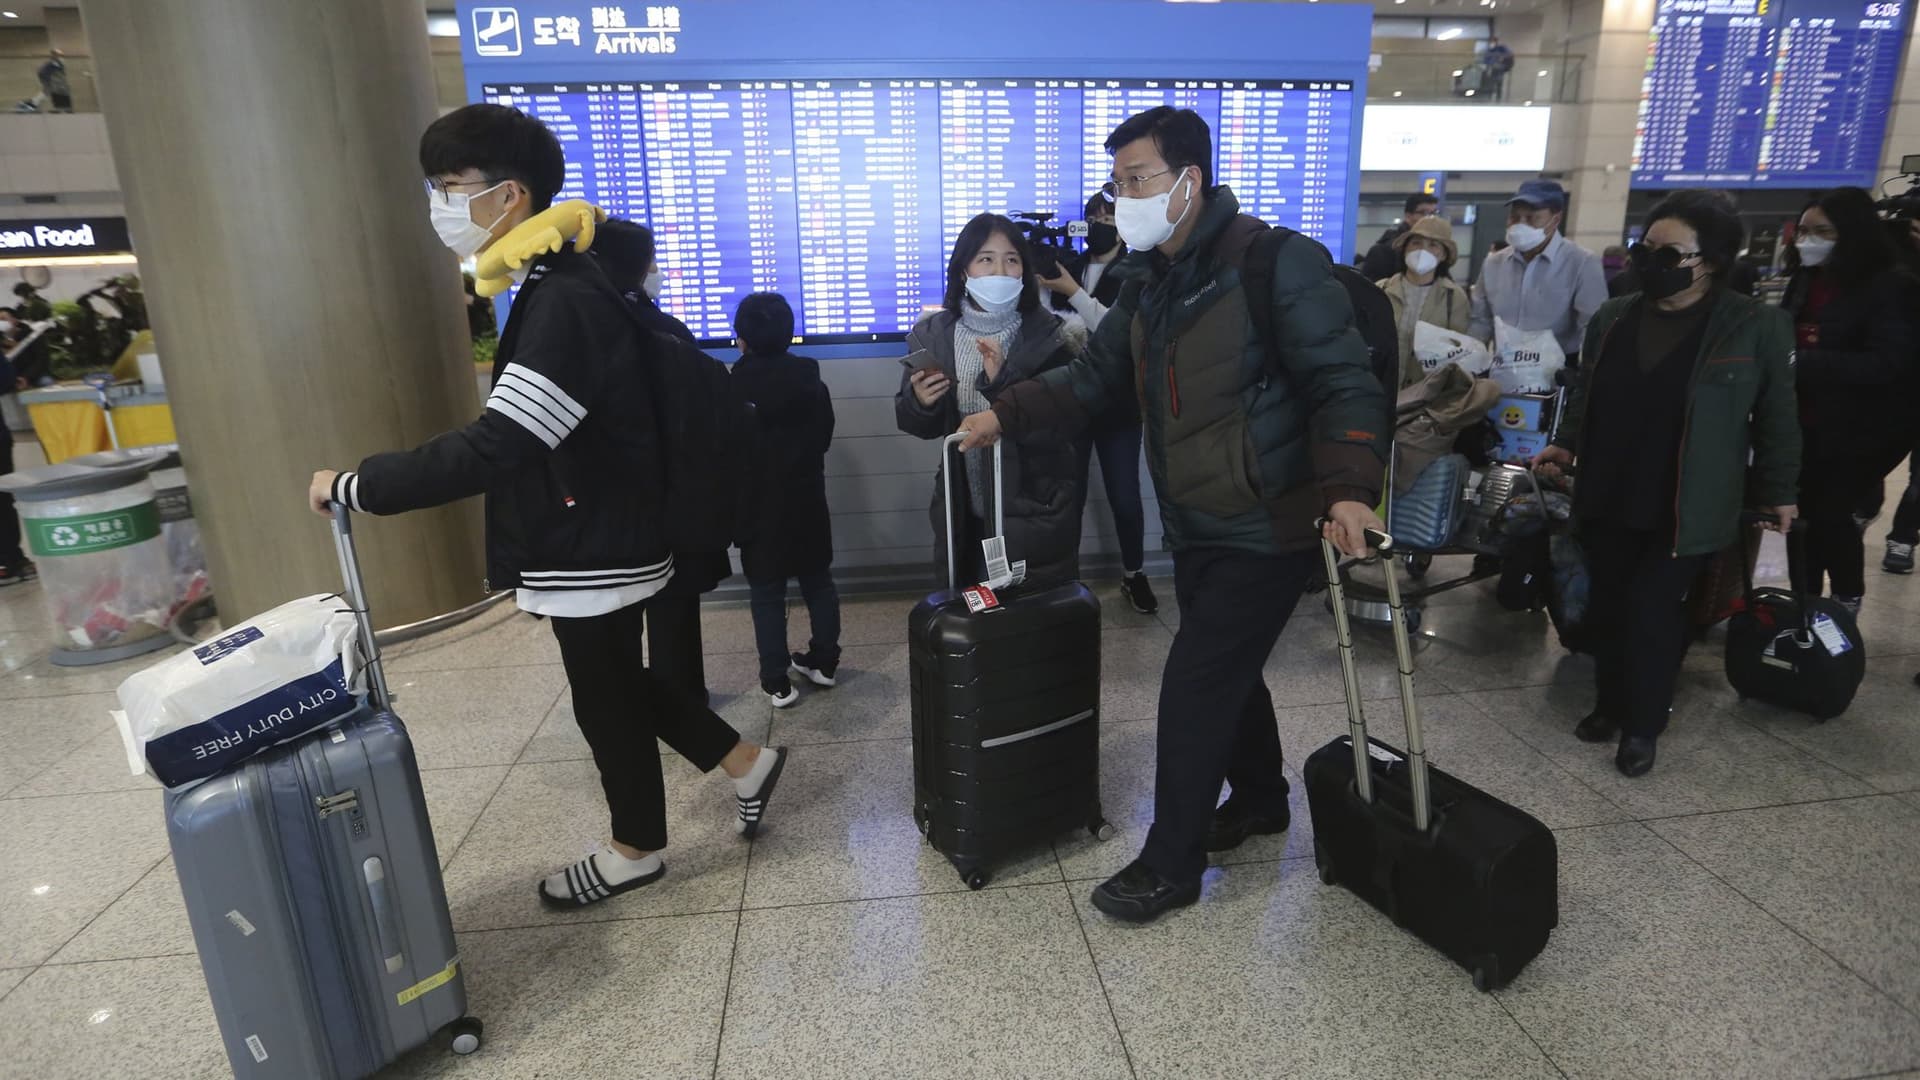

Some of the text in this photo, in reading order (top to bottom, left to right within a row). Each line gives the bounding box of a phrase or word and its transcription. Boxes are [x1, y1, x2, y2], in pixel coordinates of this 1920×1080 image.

[533, 16, 581, 46] 도착
[595, 31, 676, 54] Arrivals
[34, 223, 95, 247] Food
[1513, 350, 1542, 364] Buy
[86, 530, 128, 545] Recycle
[191, 688, 337, 760] CITY DUTY FREE
